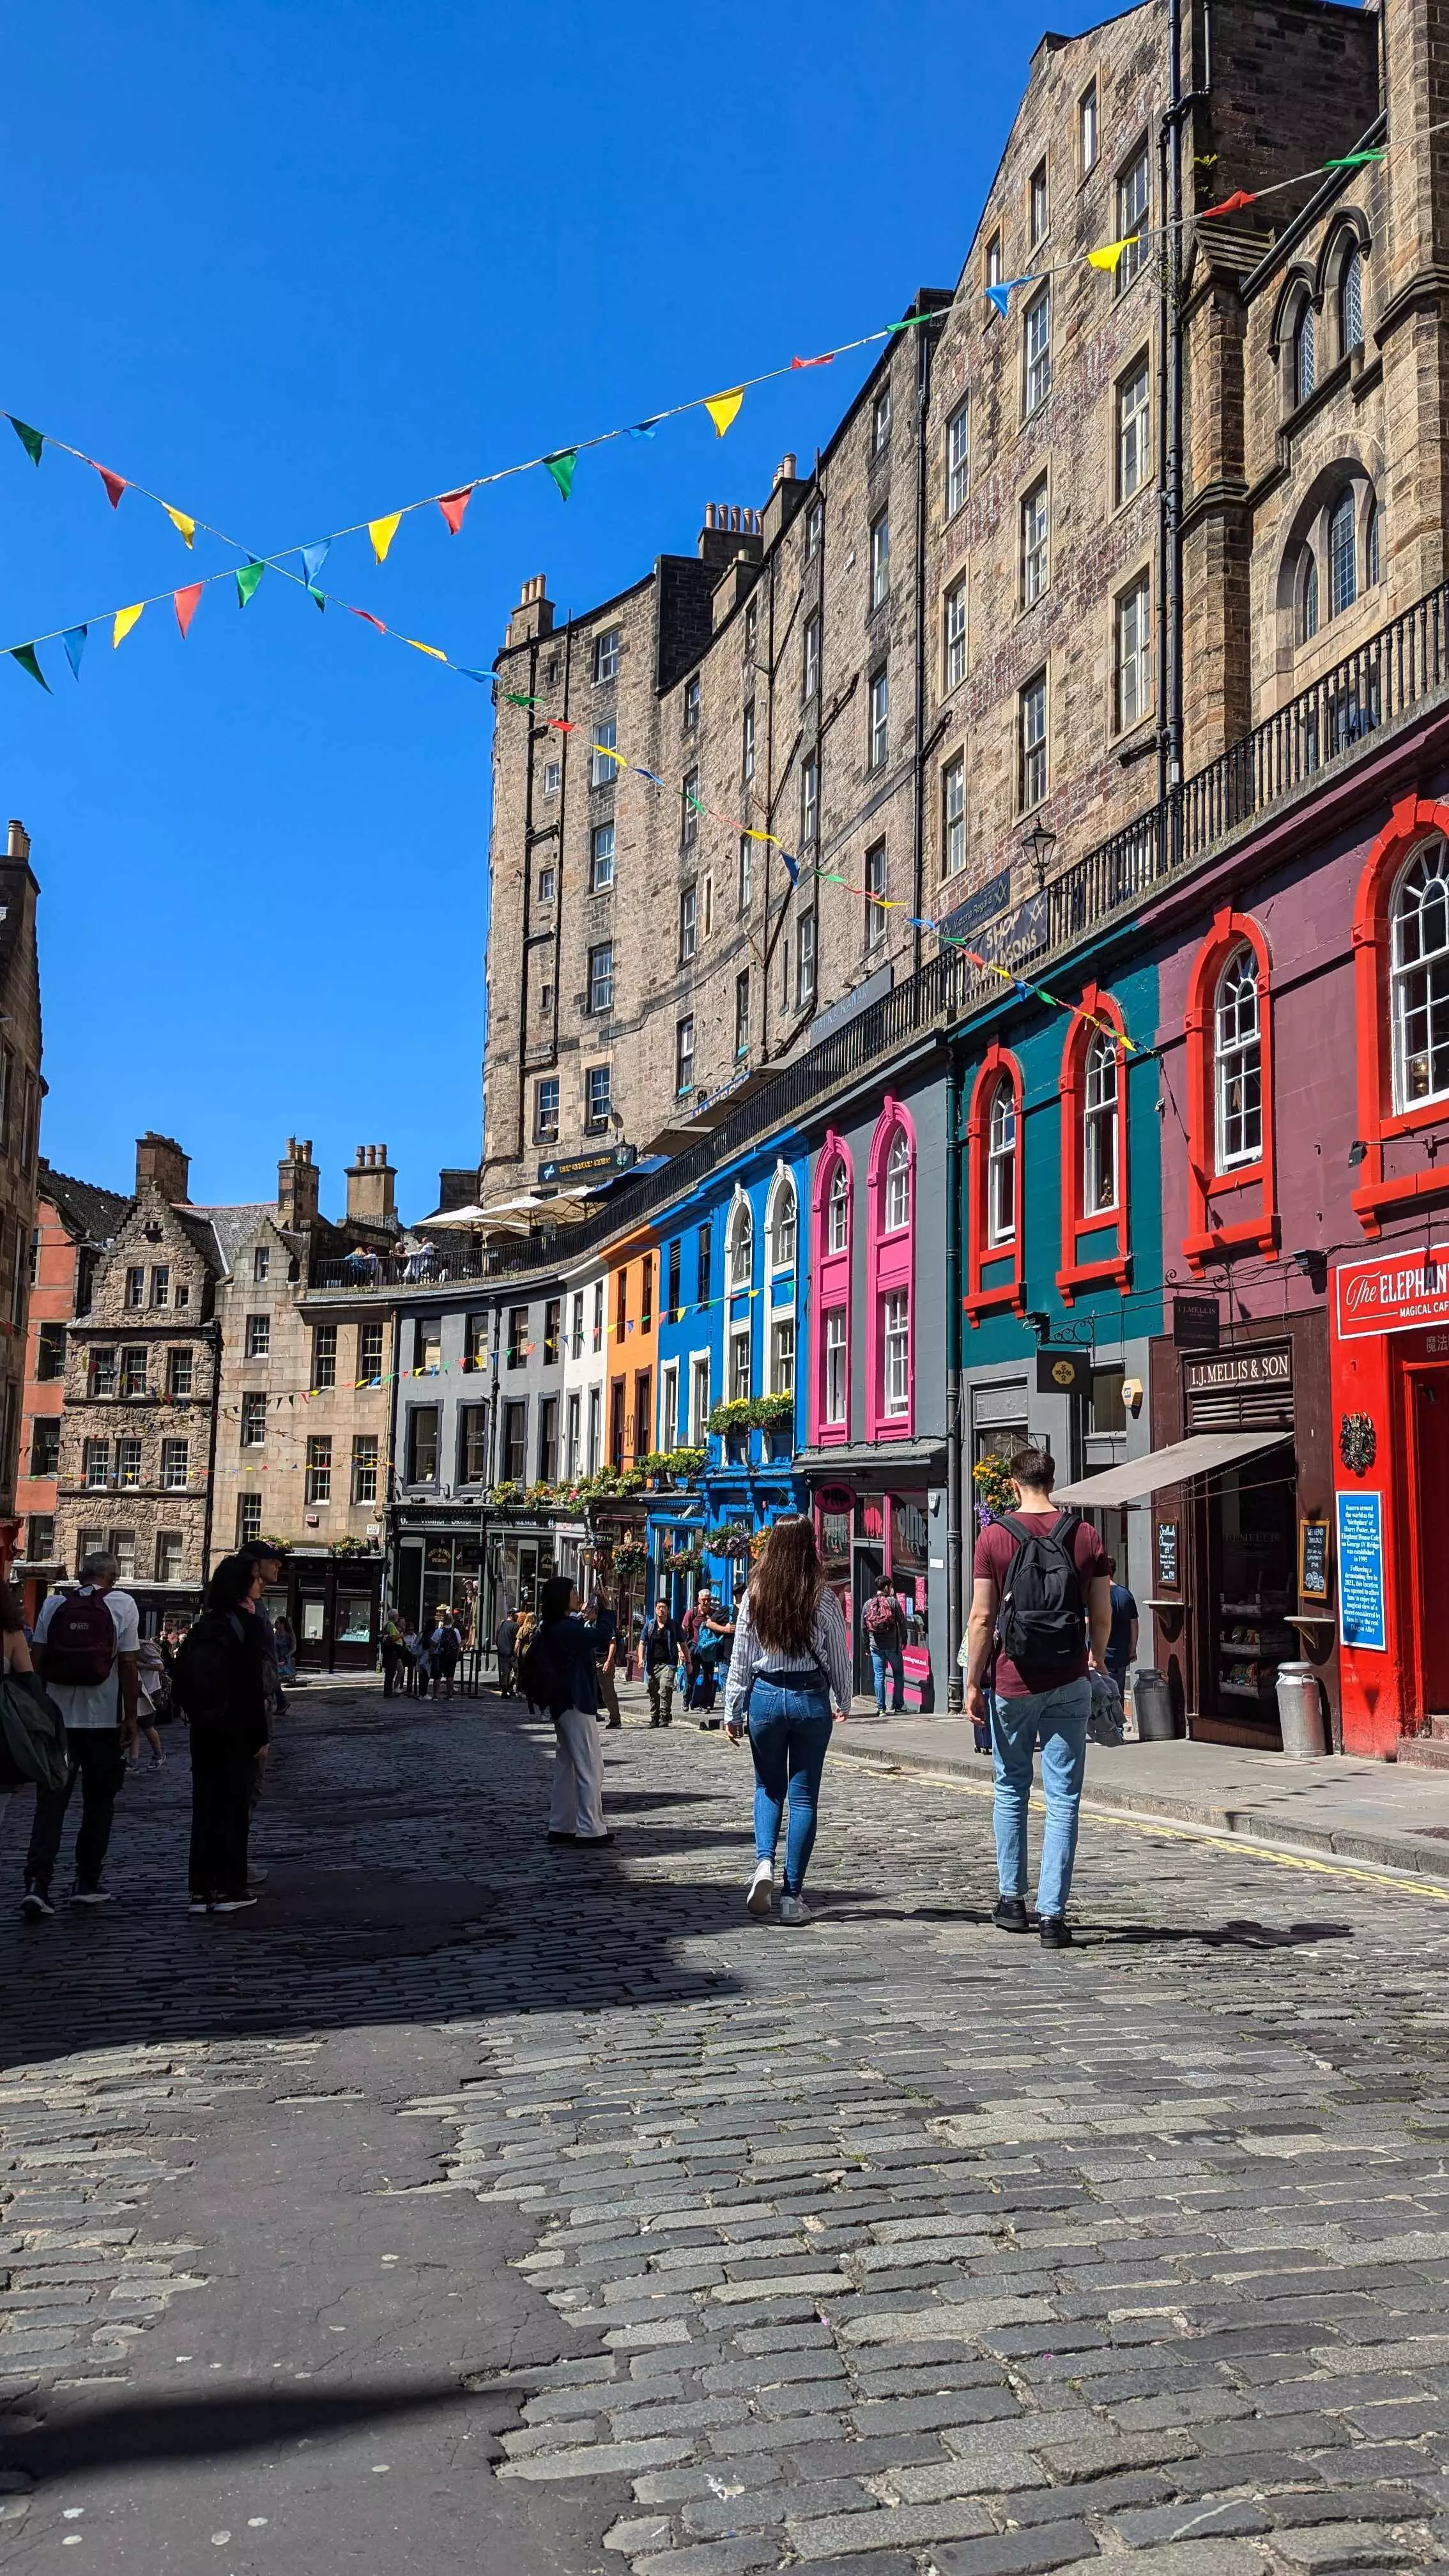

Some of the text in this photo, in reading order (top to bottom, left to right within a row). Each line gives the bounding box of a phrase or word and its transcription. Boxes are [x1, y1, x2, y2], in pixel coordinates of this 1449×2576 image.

[954, 894, 992, 930] Victoria Regalia
[986, 908, 1021, 949] SHOP
[1346, 1263, 1449, 1312] The ELEPHAN
[1400, 1304, 1431, 1318] MAGICAL
[1427, 1334, 1449, 1353] 魔法
[1251, 1359, 1259, 1377] &
[1262, 1355, 1289, 1377] SON
[625, 1414, 634, 1446] 40
[1342, 1533, 1358, 1542] Elephant
[1350, 1565, 1369, 1574] Following
